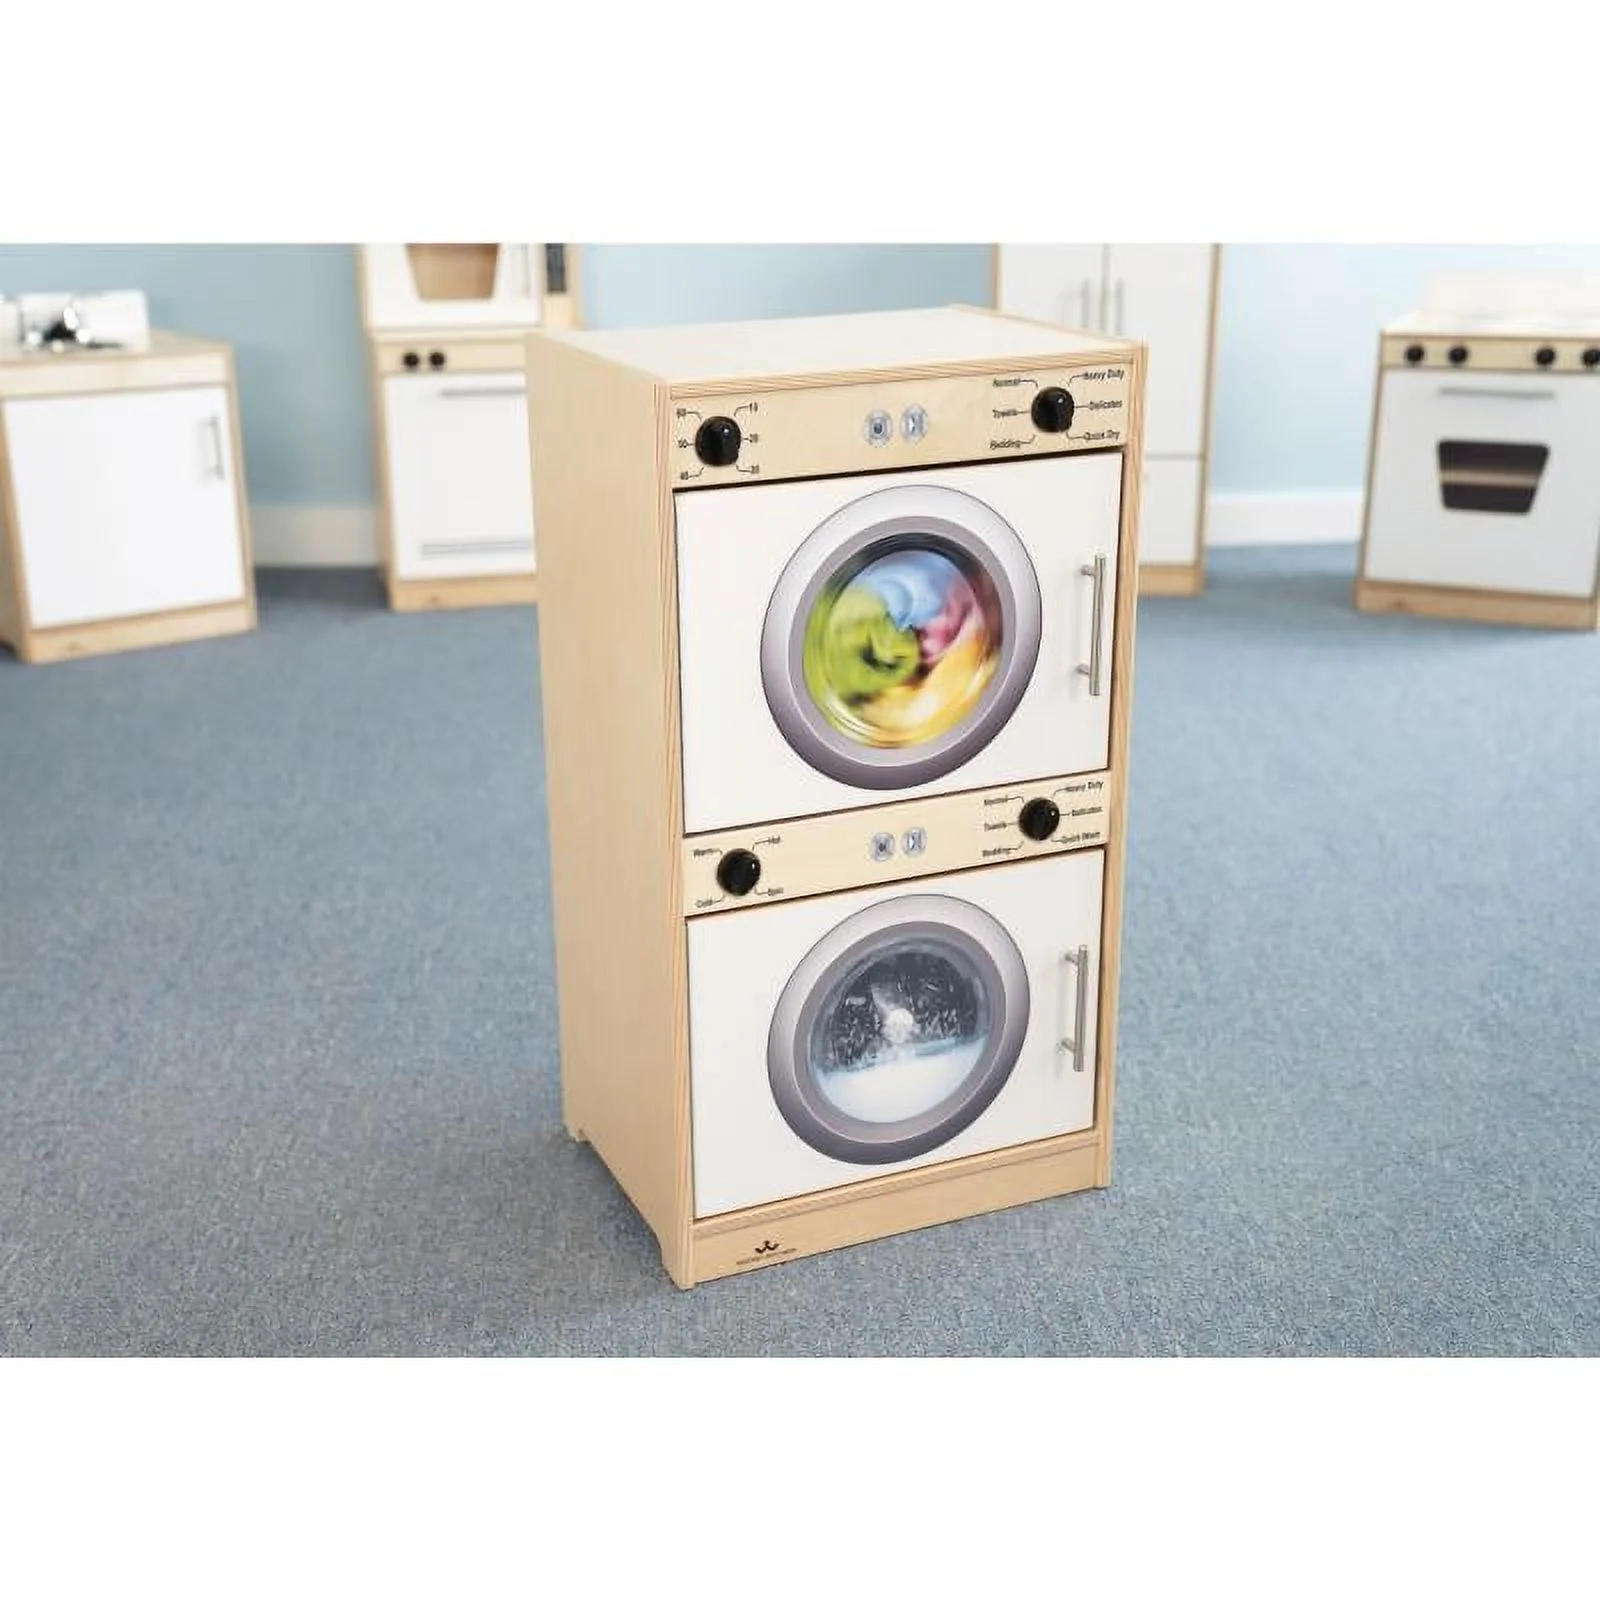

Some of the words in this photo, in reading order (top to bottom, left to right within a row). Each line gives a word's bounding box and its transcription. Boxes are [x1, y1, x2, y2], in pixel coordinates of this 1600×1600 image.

[1106, 369, 1124, 380] Duty
[1088, 400, 1122, 411] Delicates
[1106, 429, 1121, 440] Dry
